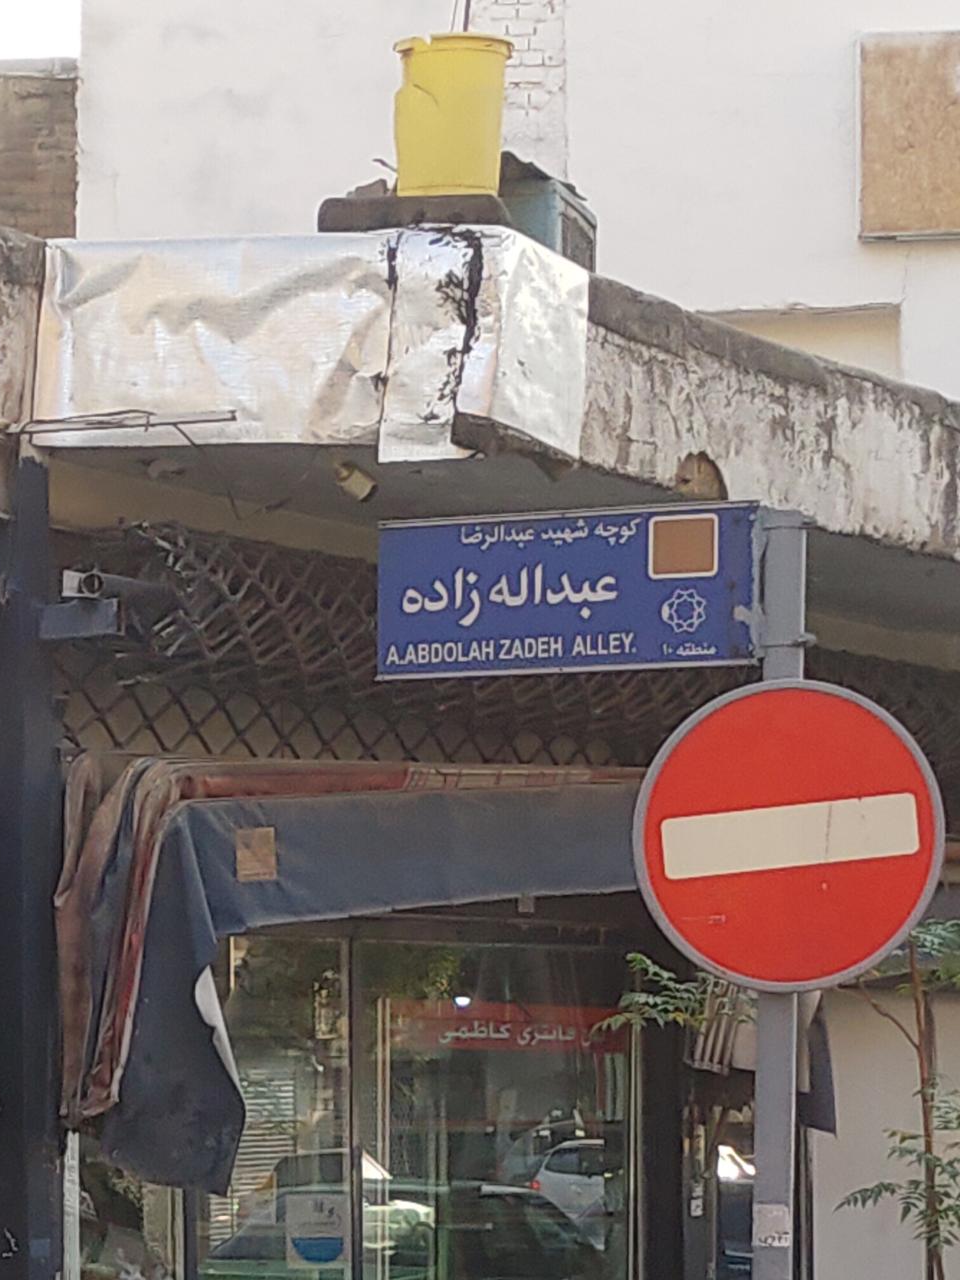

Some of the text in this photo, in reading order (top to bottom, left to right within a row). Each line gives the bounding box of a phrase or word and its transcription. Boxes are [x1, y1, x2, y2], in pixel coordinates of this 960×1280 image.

[460, 517, 642, 551] کوچه شهید عبدالرضا
[401, 562, 618, 627] عبداله زاده
[386, 632, 637, 665] A.ABDOLAH ZADEH ALLEY.
[676, 643, 717, 656] منطقه
[439, 1019, 512, 1043] کاظمی
